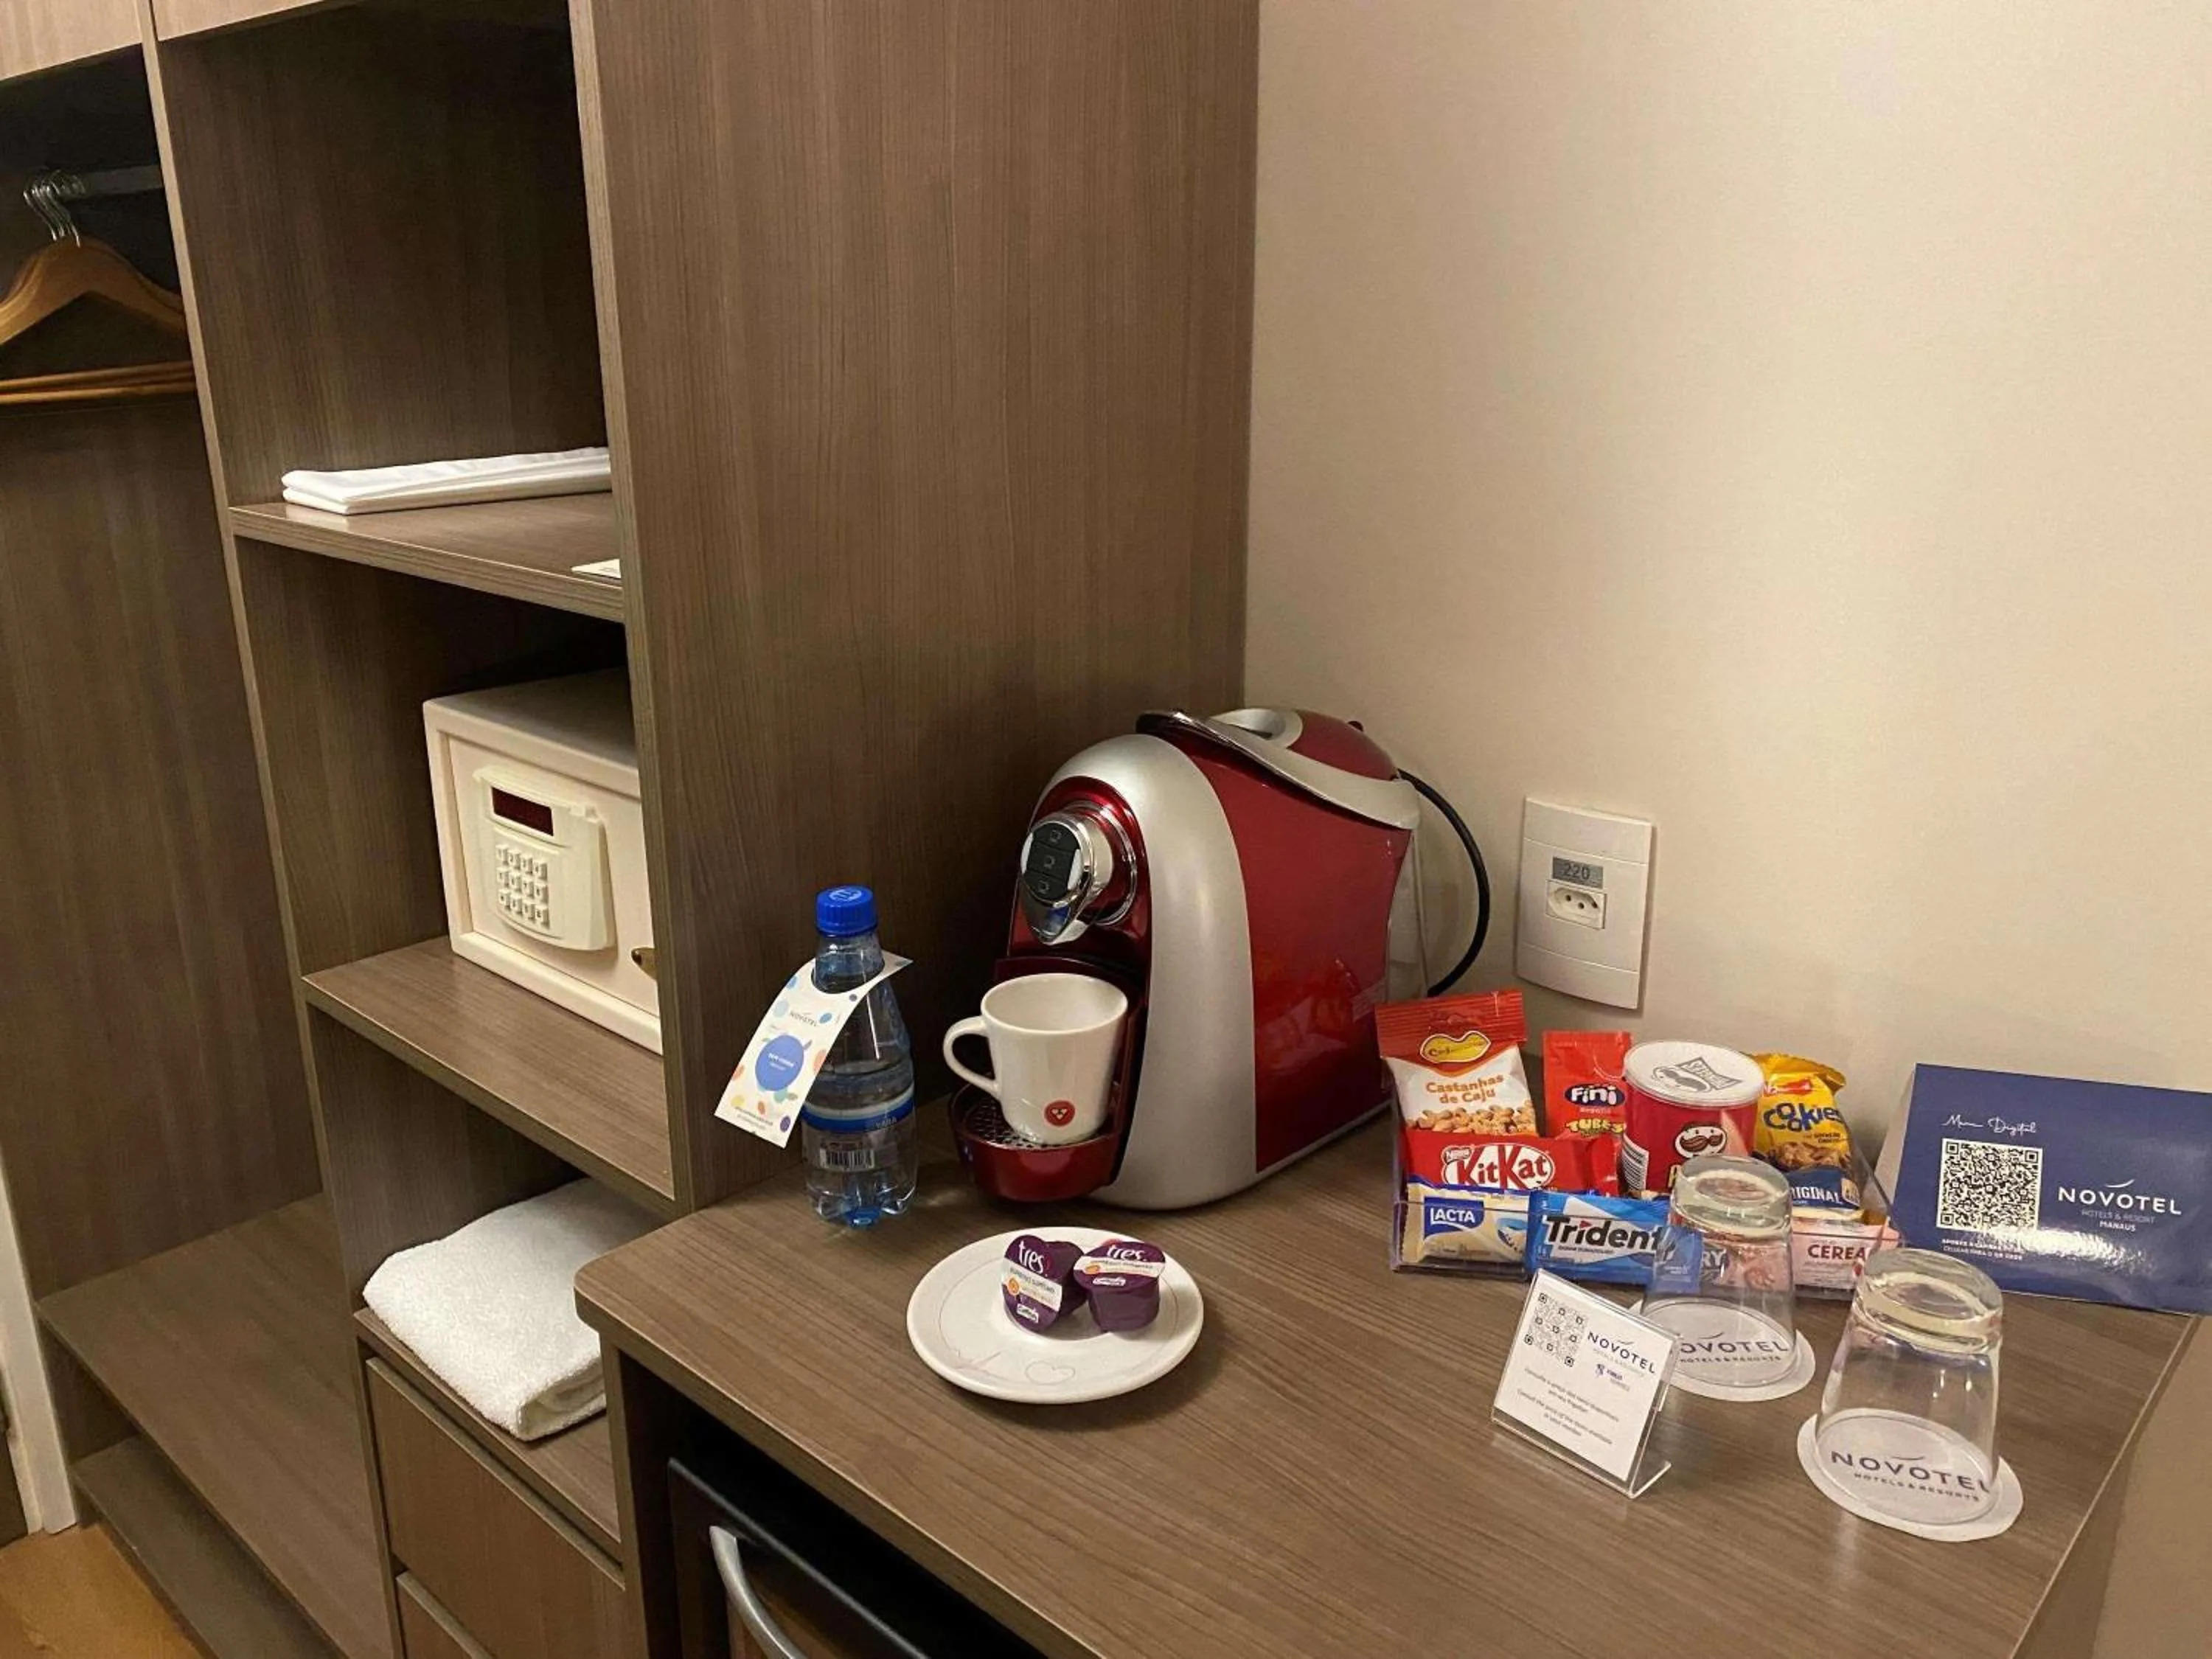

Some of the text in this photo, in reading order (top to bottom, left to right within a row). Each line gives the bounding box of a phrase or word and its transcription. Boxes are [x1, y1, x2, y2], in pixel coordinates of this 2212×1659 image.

[1563, 862, 1591, 880] 220
[1426, 1074, 1504, 1093] Castanhas
[1439, 1088, 1496, 1104] de Caju
[1571, 1085, 1617, 1105] Fini
[1456, 1144, 1548, 1191] KitKat
[2058, 1186, 2182, 1216] NOVOTEL
[1430, 1207, 1475, 1225] LACTA
[1545, 1216, 1663, 1251] Trident
[2099, 1221, 2136, 1233] MANAUS
[1807, 1244, 1866, 1260] CEREA
[1587, 1331, 1655, 1374] NOVOTEL
[1680, 1341, 1789, 1354] OVOTEL
[1830, 1450, 1990, 1494] NOVOTEL
[1854, 1472, 1905, 1487] HOTELS
